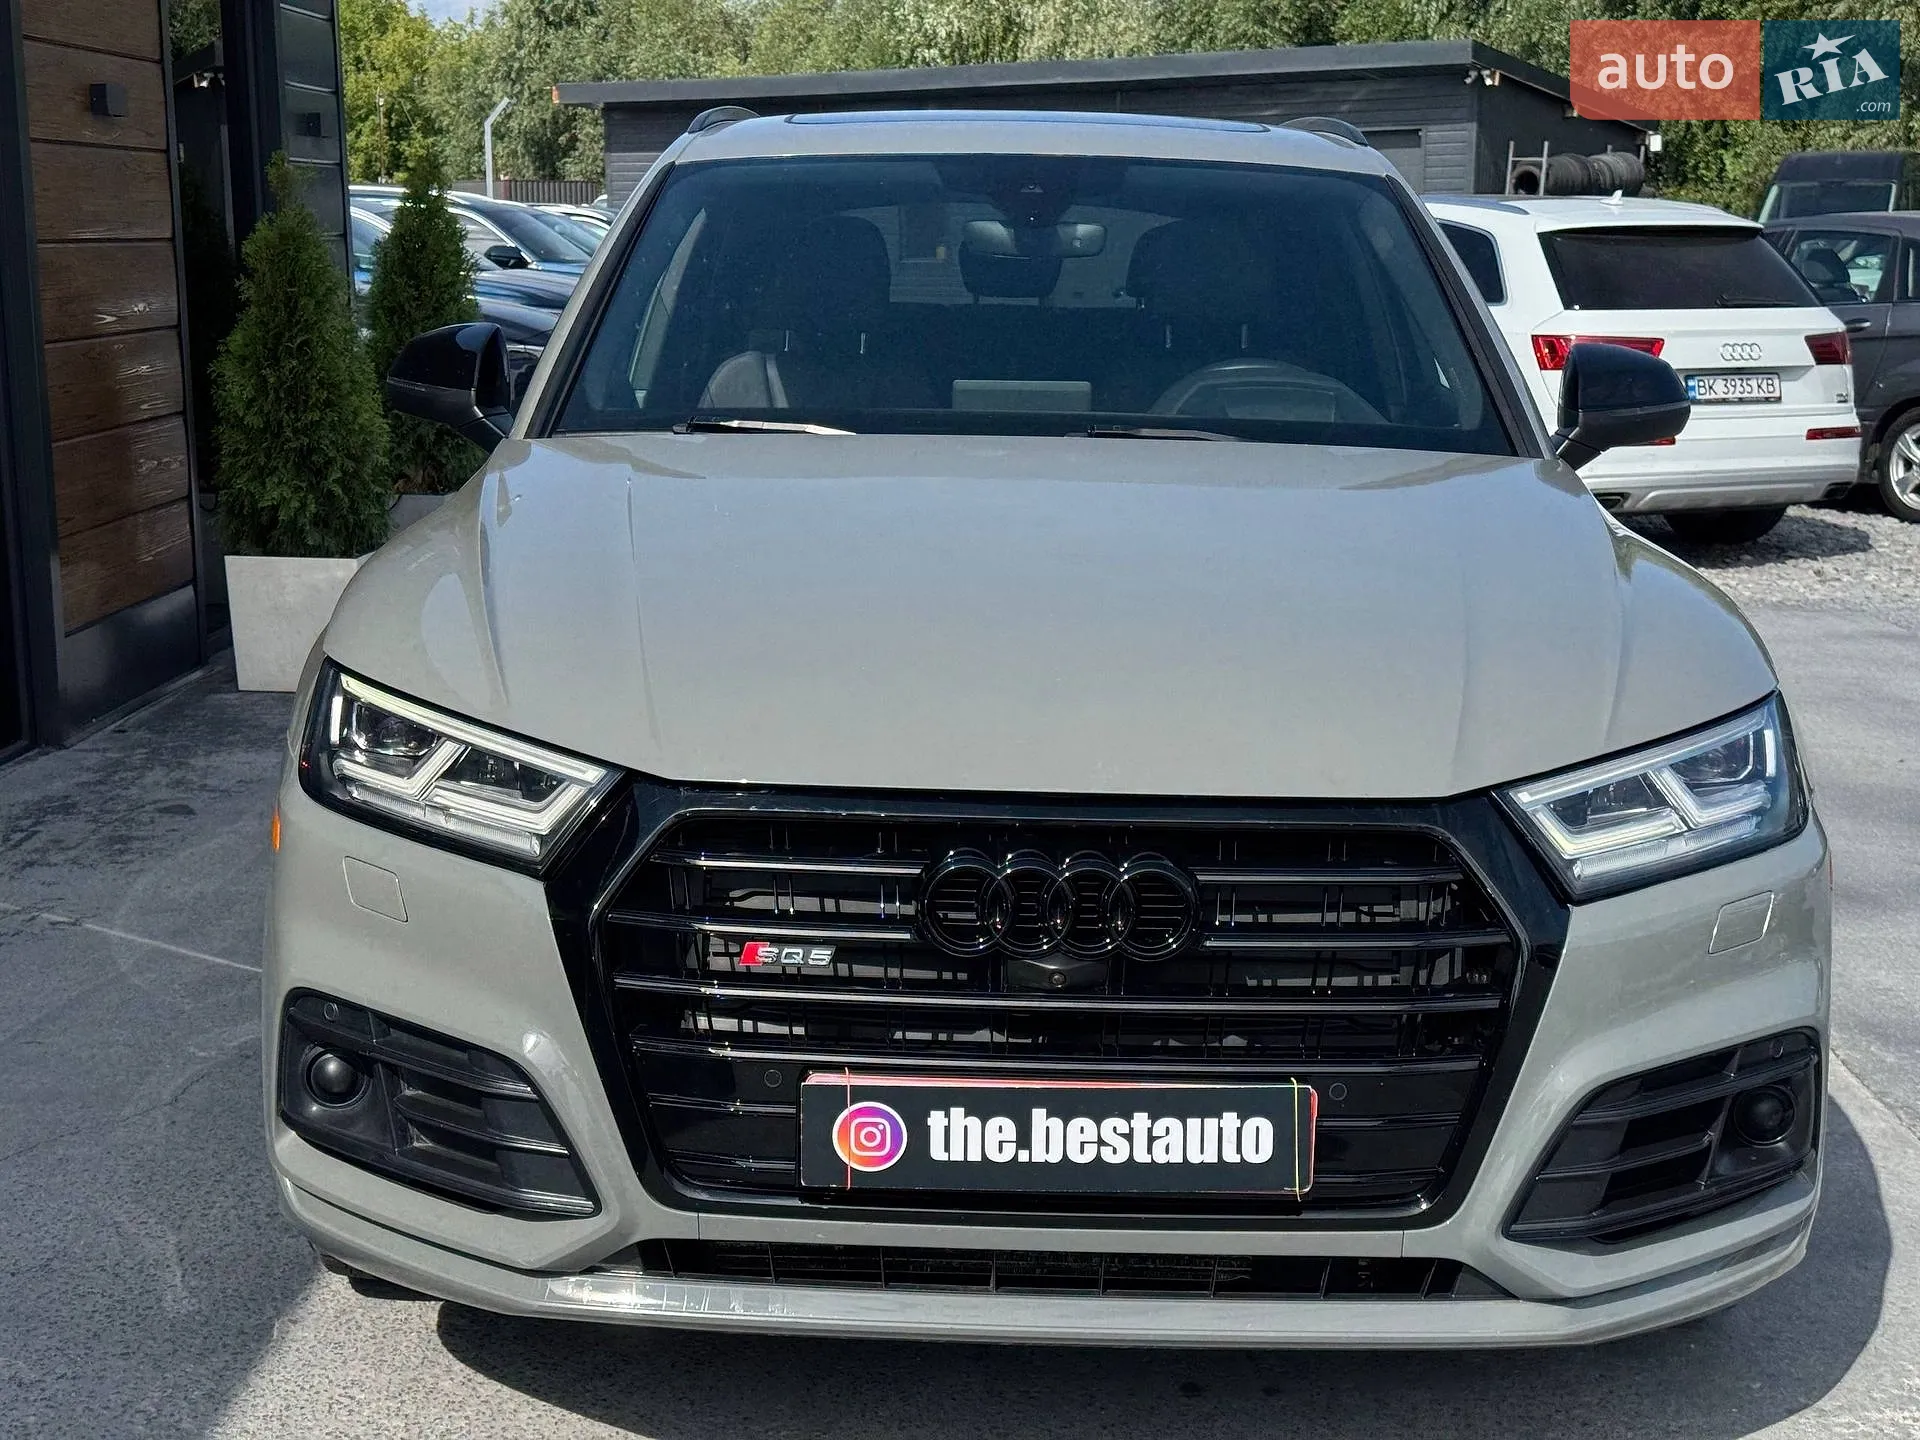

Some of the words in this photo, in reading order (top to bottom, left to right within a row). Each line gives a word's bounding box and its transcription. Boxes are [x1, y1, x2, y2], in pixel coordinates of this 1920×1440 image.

[1697, 379, 1718, 396] BK
[1722, 378, 1753, 395] 3935
[1756, 377, 1776, 394] KB
[755, 947, 832, 966] SQ5
[927, 1107, 1274, 1164] the.bestauto
